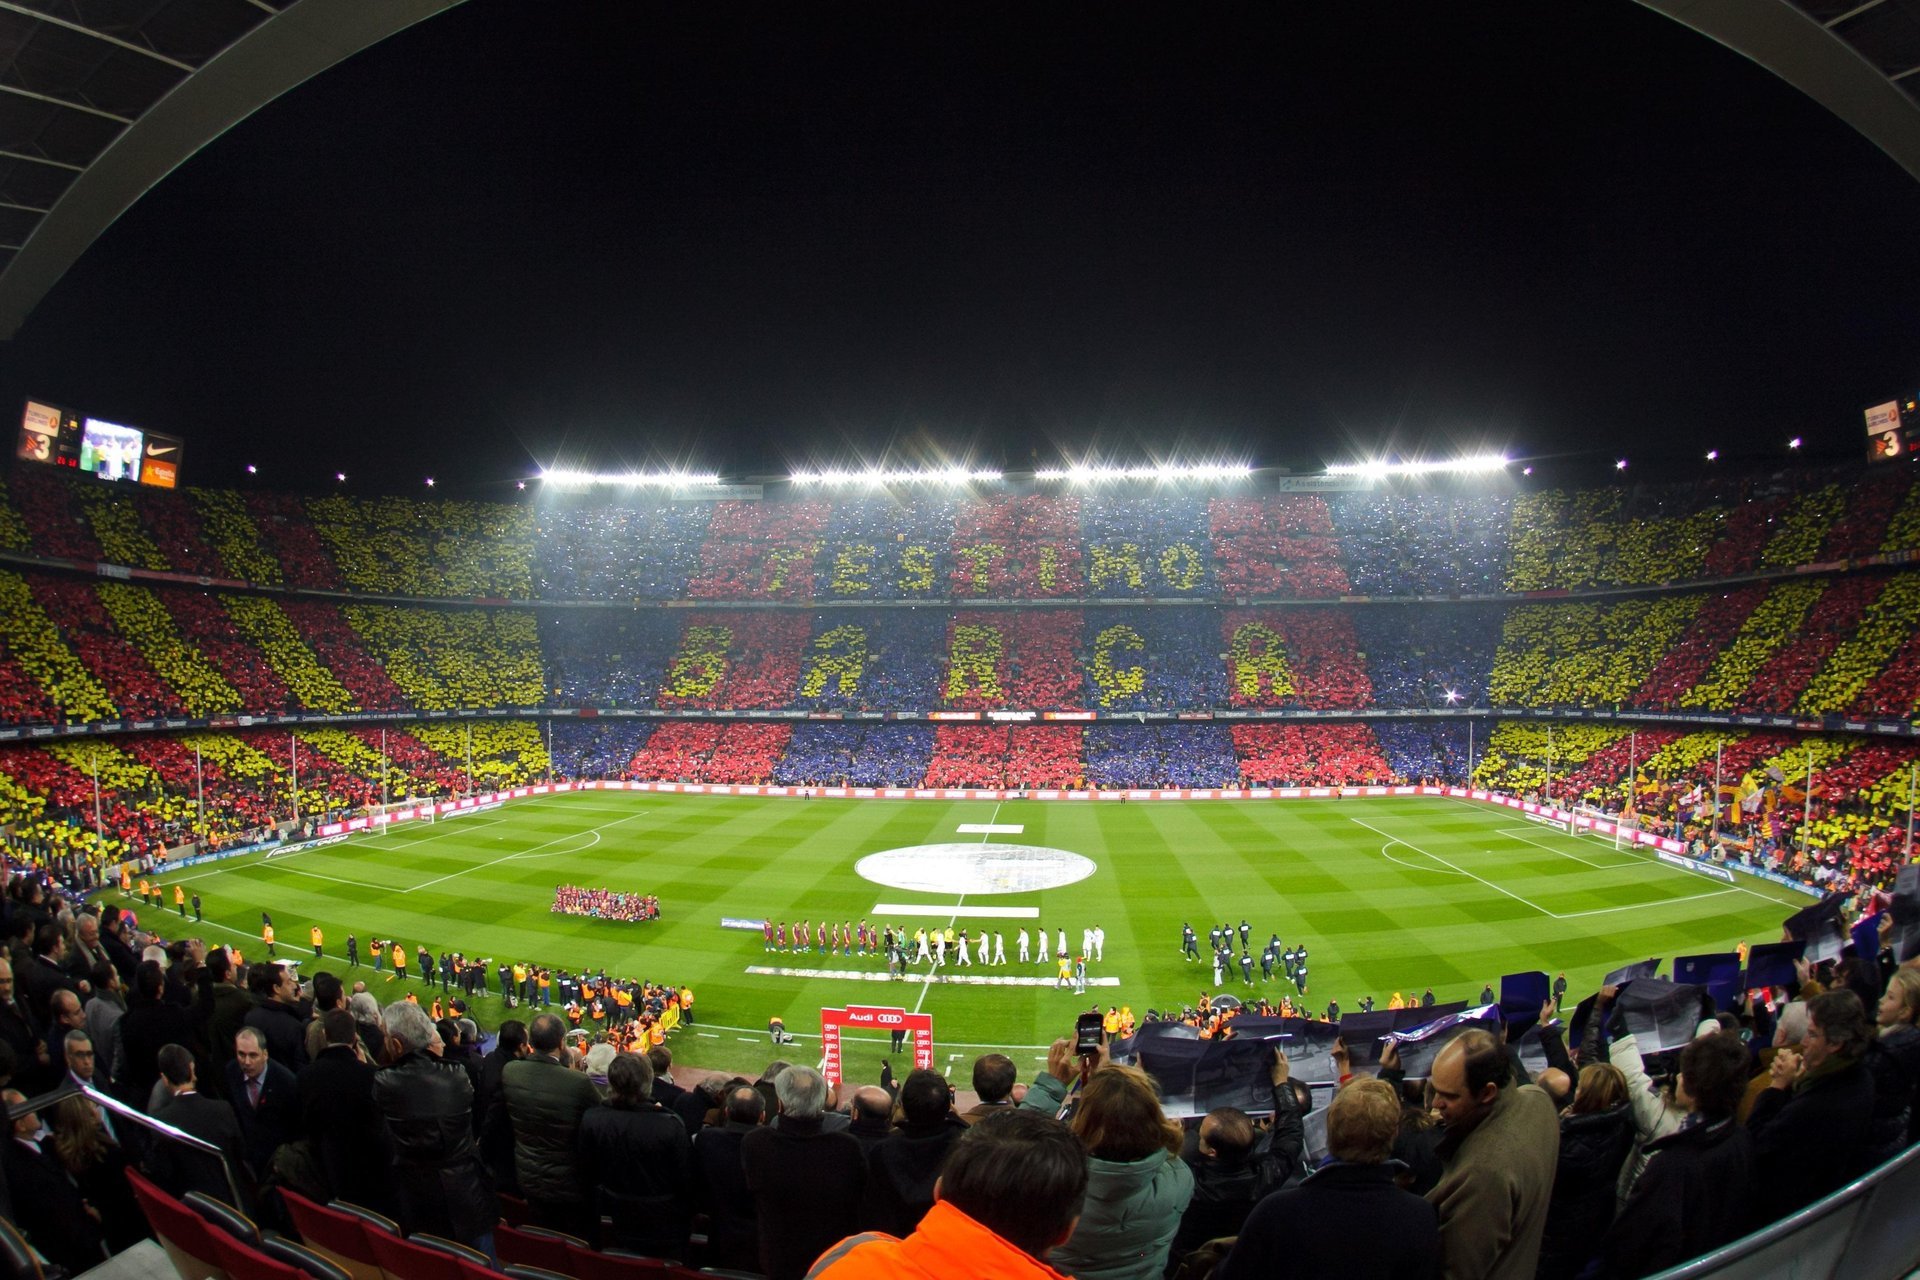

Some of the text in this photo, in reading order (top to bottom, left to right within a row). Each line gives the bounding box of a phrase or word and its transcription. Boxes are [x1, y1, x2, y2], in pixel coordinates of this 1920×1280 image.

[34, 434, 50, 460] 3
[1883, 431, 1900, 456] 3
[849, 1013, 873, 1022] Audi
